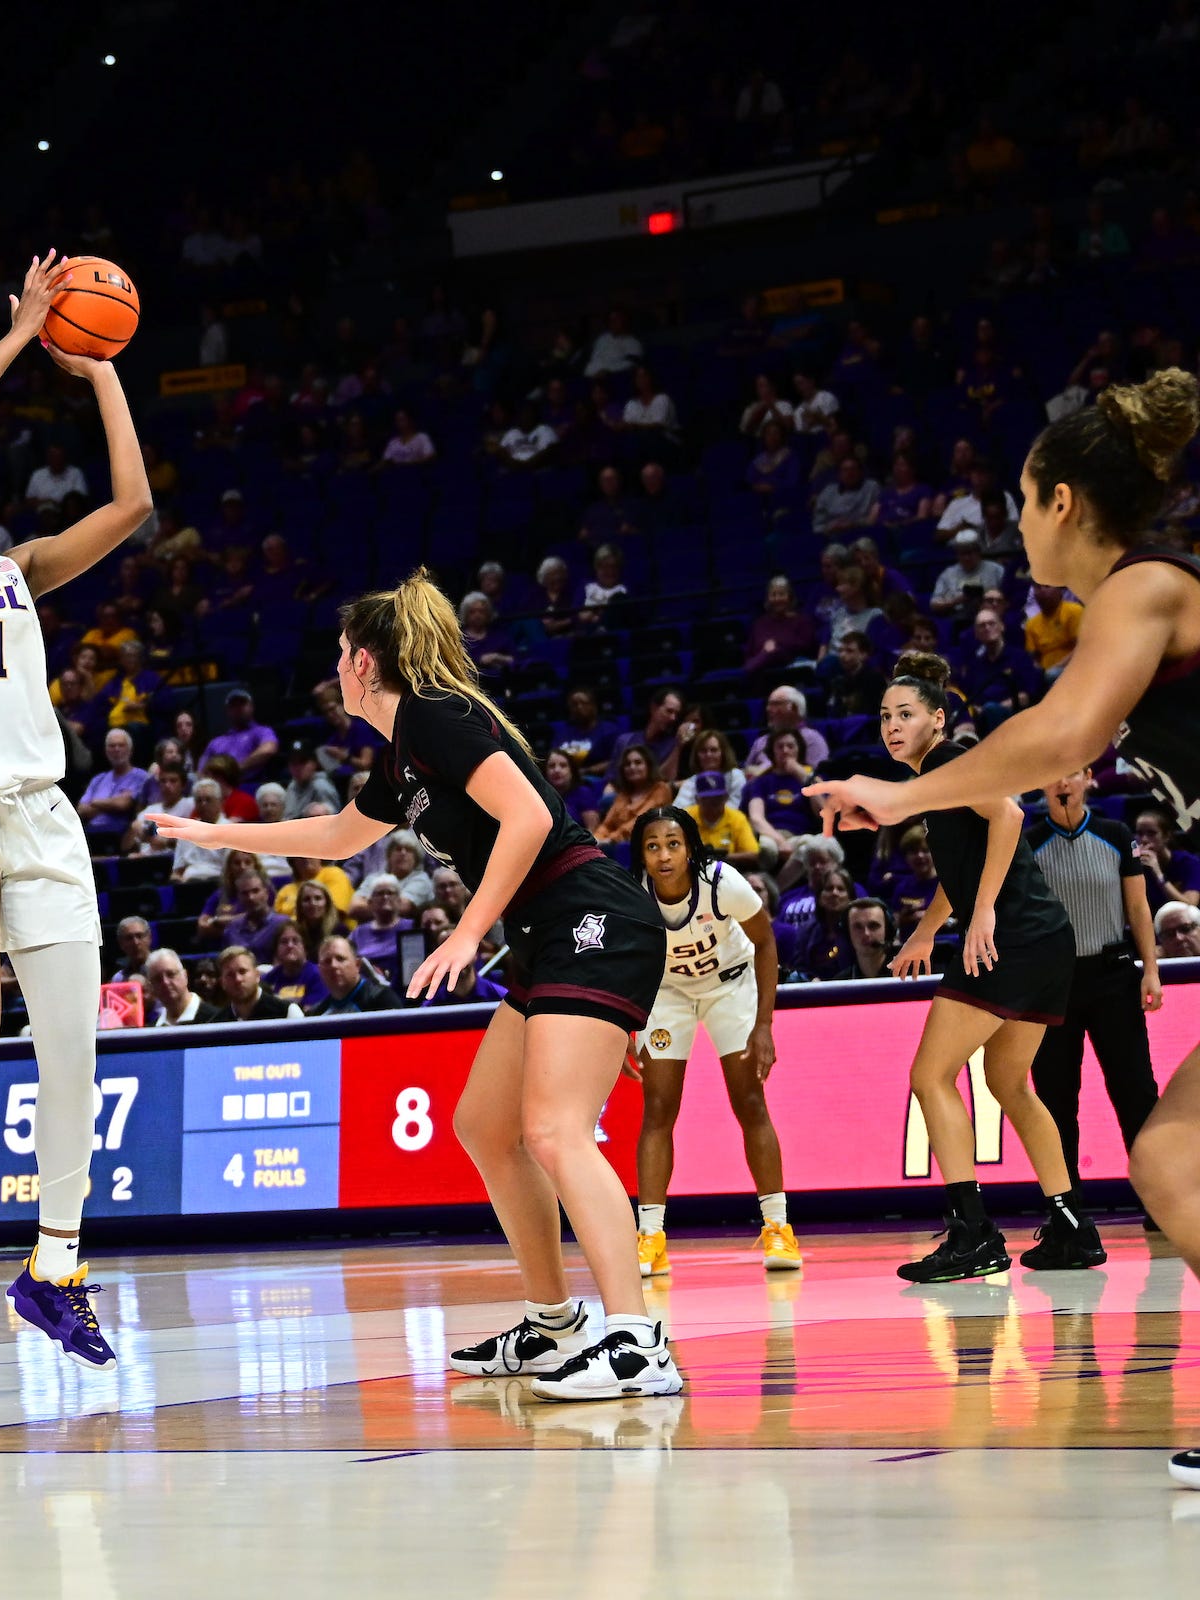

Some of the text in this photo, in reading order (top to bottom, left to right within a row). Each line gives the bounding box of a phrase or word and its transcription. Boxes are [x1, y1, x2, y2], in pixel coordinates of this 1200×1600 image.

[668, 957, 720, 977] 45
[233, 1063, 302, 1081] TIME OUTS
[392, 1086, 434, 1151] 8
[253, 1148, 299, 1167] TEAM
[223, 1153, 246, 1188] 4
[252, 1168, 307, 1188] FOULS
[112, 1166, 134, 1201] 2
